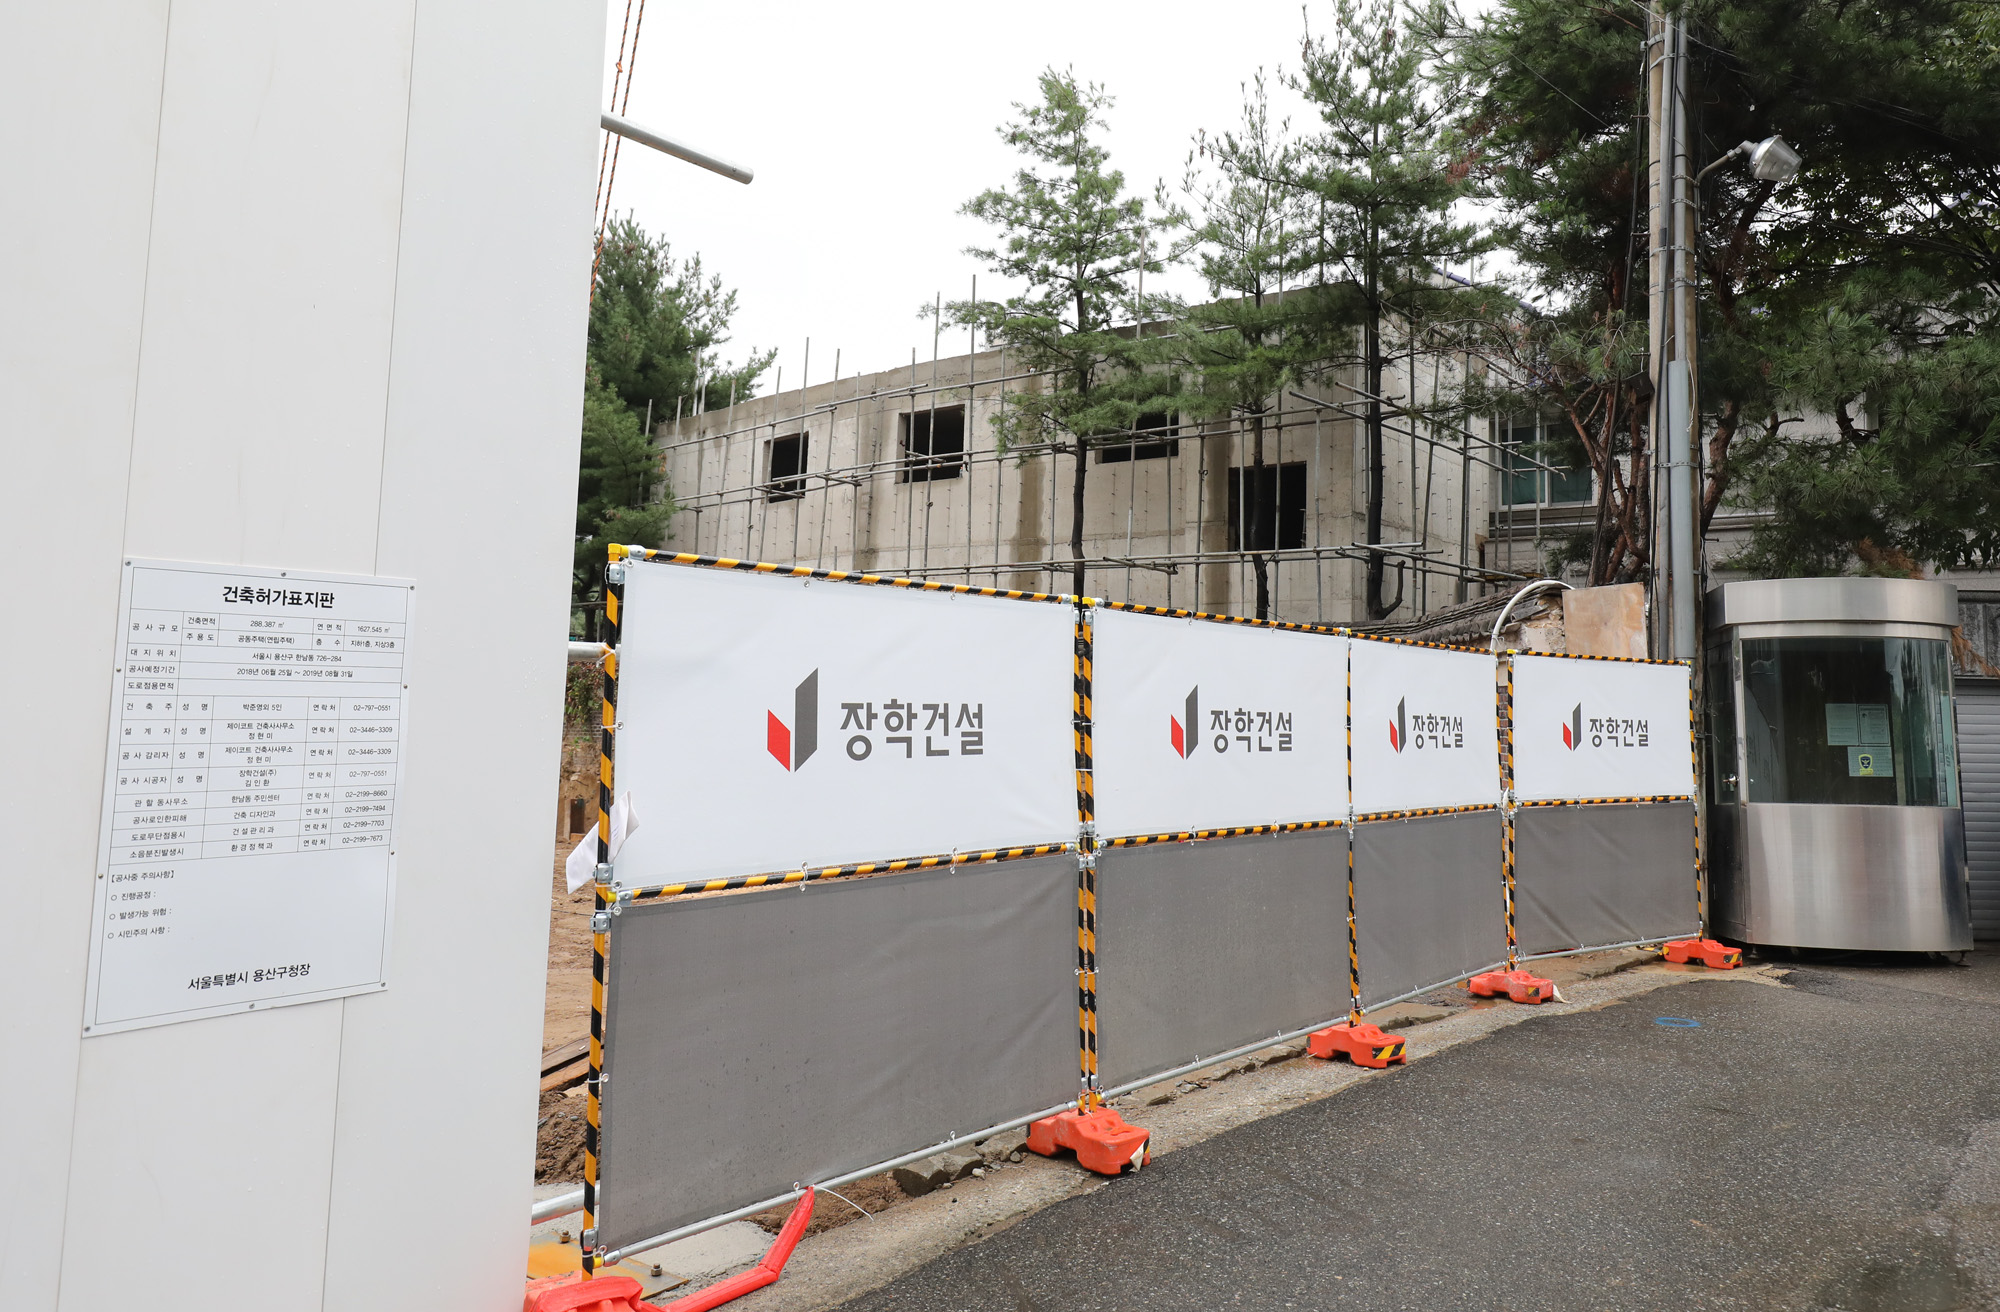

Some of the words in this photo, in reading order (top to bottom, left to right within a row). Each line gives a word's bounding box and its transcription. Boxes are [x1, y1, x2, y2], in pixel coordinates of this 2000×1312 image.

[222, 586, 335, 609] 건축허가표지판
[188, 616, 216, 625] 건축면적
[250, 620, 276, 628] 288.387
[238, 635, 295, 644] 공동주택(연립주택)
[374, 641, 395, 649] 지상3층
[252, 653, 272, 661] 서울시
[274, 653, 293, 661] 용산구
[295, 654, 314, 662] 한남동
[129, 665, 176, 674] 공사예정기간
[237, 668, 259, 676] 2018년
[261, 668, 276, 676] 06월
[302, 670, 323, 678] 2019년
[325, 670, 340, 678] 08월
[340, 670, 353, 678] 31일
[128, 682, 174, 690] 도로점용면적
[227, 722, 253, 730] 제이코트
[256, 722, 295, 730] 건축사사무소
[840, 698, 984, 762] 장학건설
[1210, 707, 1294, 754] 장학건설
[1412, 713, 1464, 749] 장학건설
[1589, 716, 1649, 748] 장학건설
[225, 746, 252, 754] 제이코트
[254, 746, 293, 754] 건축사사무소
[239, 769, 277, 778] 장학건설(주)
[231, 795, 251, 804] 한남동
[254, 794, 280, 802] 주민센터
[345, 790, 388, 798] 02-2199-8660
[345, 805, 386, 813] 02-2199-7494
[132, 815, 187, 825] 공사로인한피해
[233, 812, 247, 820] 건축
[249, 810, 276, 818] 디자인과
[343, 820, 384, 829] 02-2199-7703
[131, 831, 186, 842] 도로무단점용시
[342, 835, 383, 844] 02-2199-7673
[129, 848, 184, 858] 소음분진발생시
[121, 891, 151, 901] 진행공정
[119, 910, 149, 920] 발생가능
[118, 928, 148, 939] 시민주의
[188, 971, 249, 990] 서울특별시
[252, 963, 311, 982] 용산구청장
